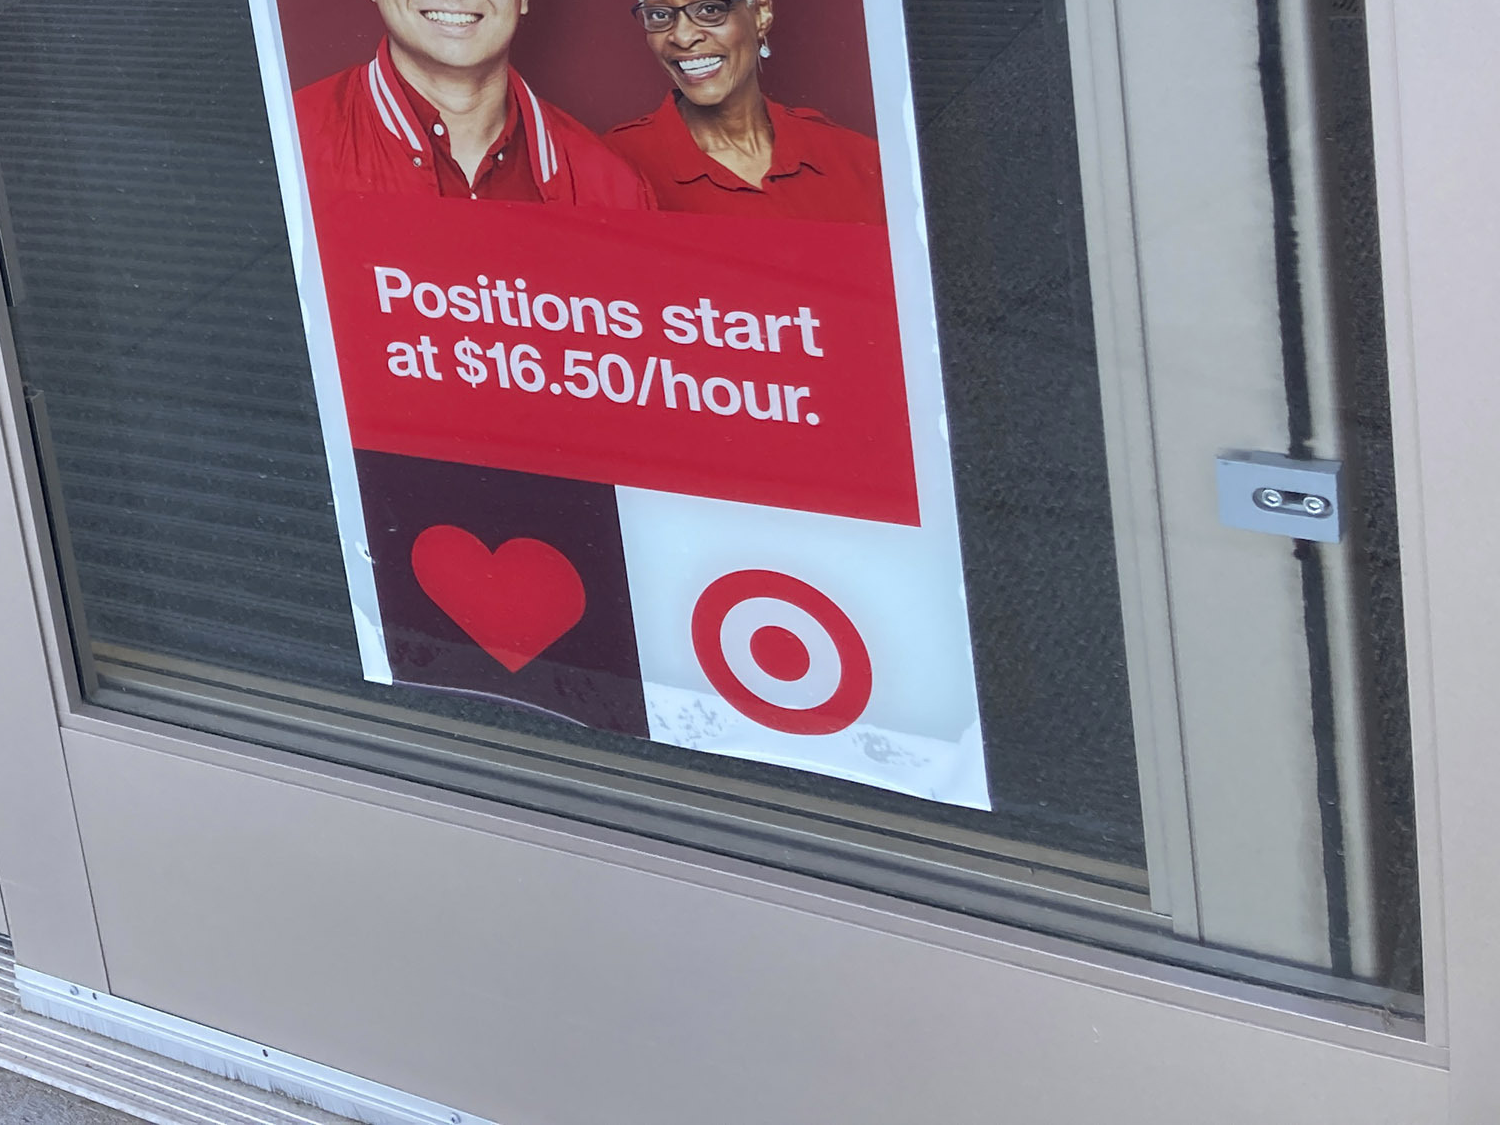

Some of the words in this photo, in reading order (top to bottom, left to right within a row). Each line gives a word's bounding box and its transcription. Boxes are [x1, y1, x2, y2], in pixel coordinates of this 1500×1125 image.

[372, 265, 643, 341] Positions
[662, 297, 826, 359] start
[384, 335, 443, 382] at
[454, 336, 821, 427] $16.50/hour.
